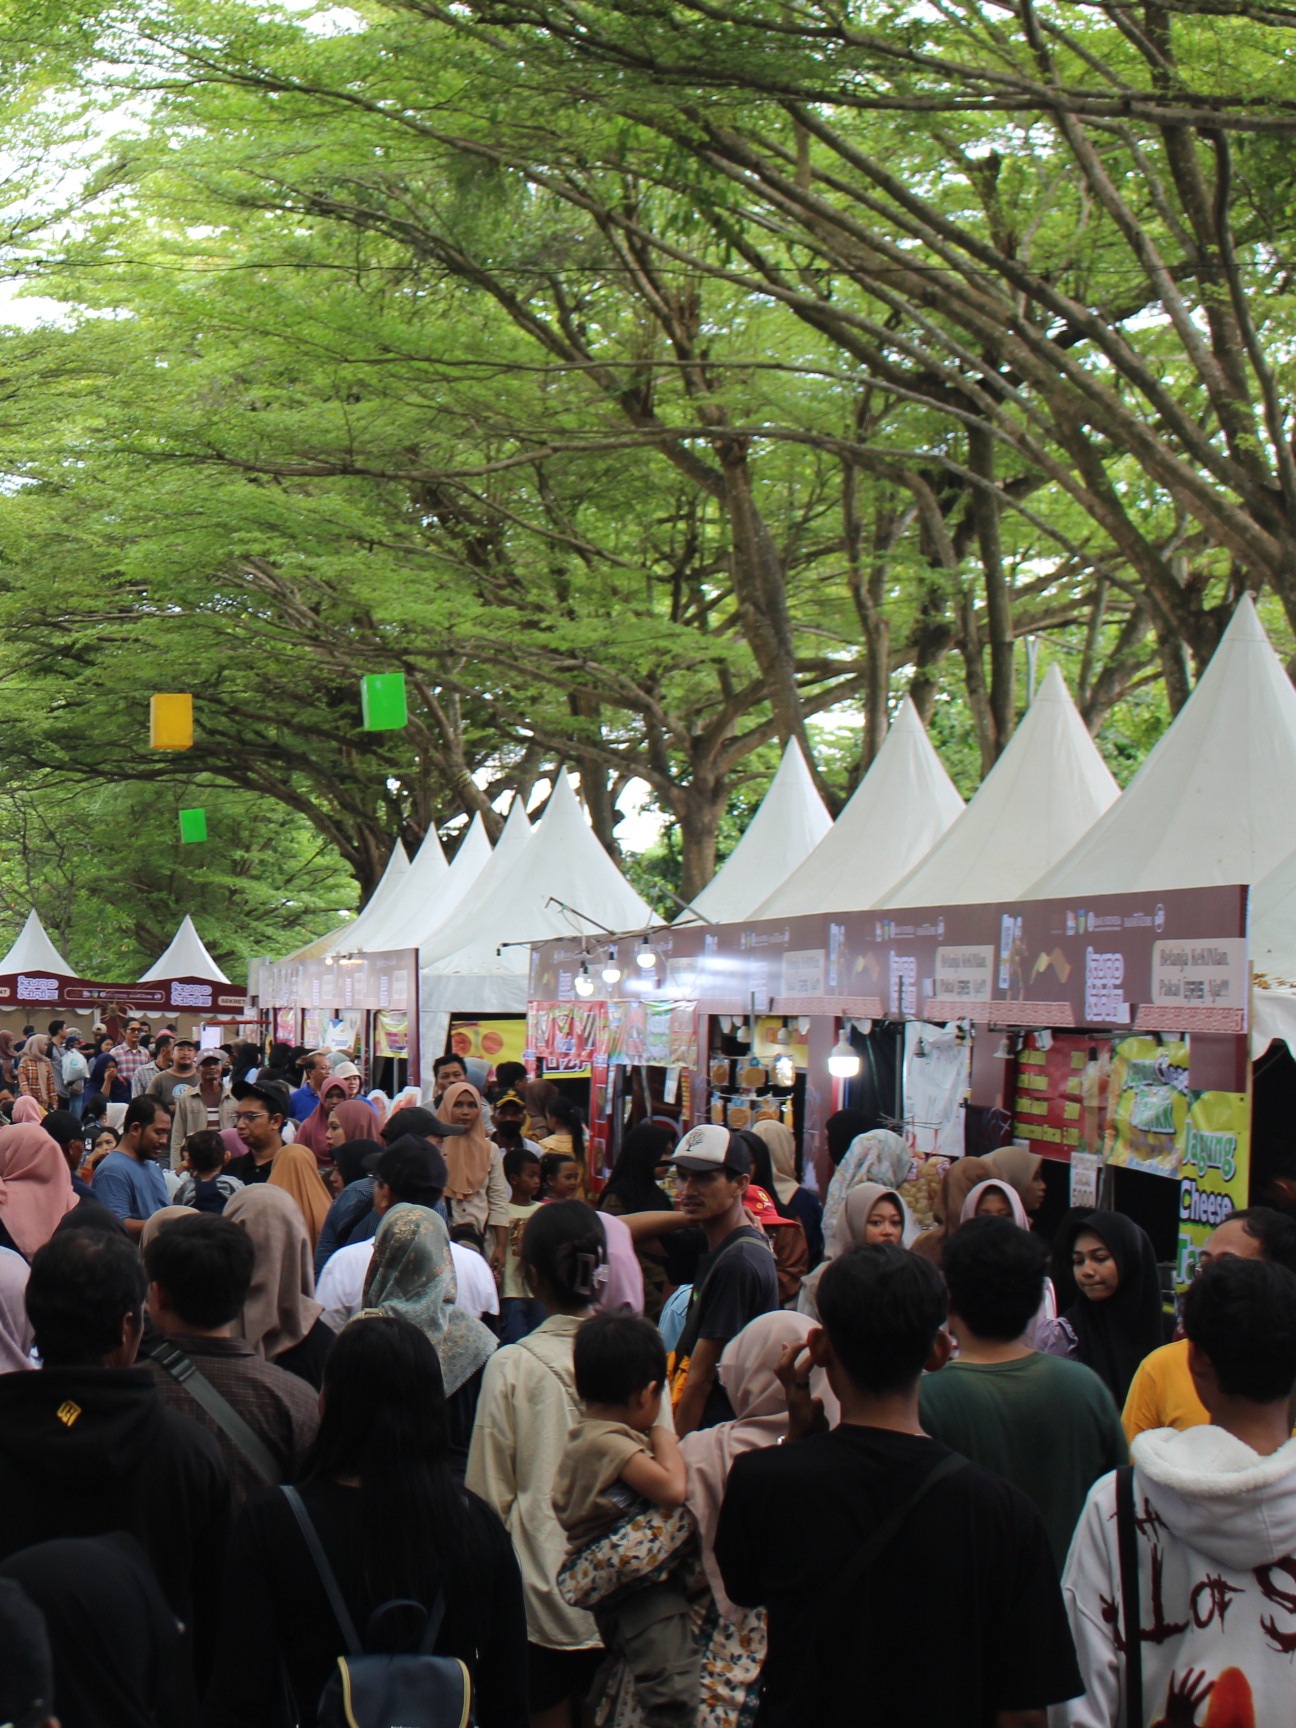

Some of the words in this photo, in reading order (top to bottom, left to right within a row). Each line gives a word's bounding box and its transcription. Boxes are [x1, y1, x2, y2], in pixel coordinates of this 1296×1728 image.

[1160, 948, 1189, 973] Belanja
[17, 975, 59, 989] kuno
[171, 982, 212, 996] kuno
[1159, 979, 1181, 998] Pakai
[17, 988, 46, 1000] kini
[171, 993, 200, 1006] kini
[1181, 1118, 1236, 1182] Jagung
[1179, 1179, 1232, 1224] Cheese
